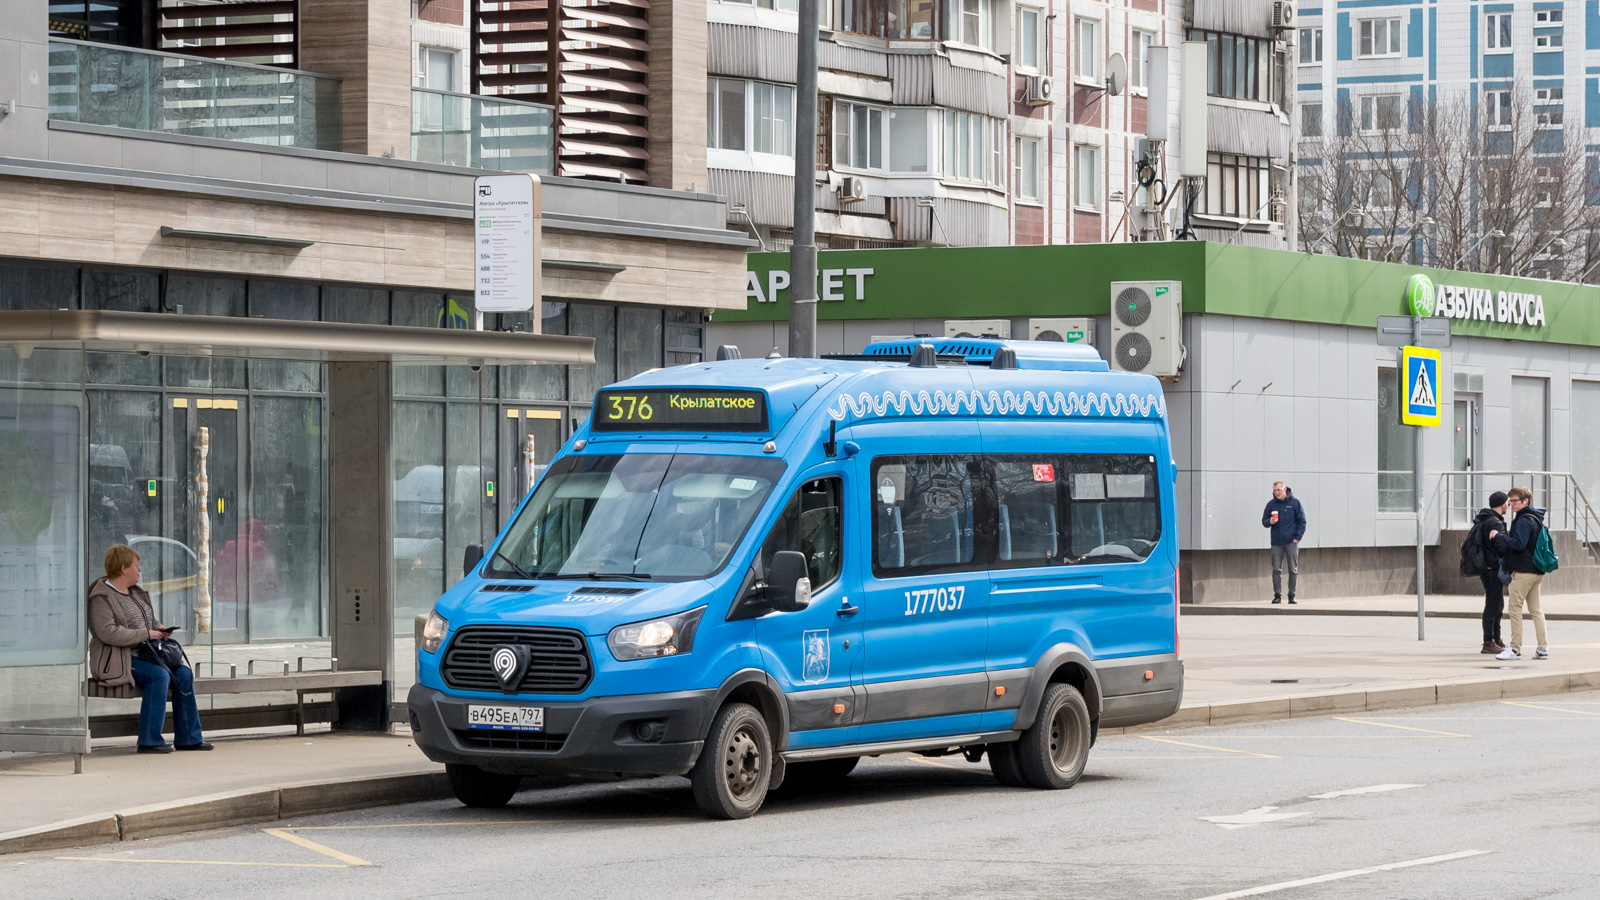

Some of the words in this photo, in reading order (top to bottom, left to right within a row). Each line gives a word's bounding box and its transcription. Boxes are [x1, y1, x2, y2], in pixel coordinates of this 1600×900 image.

[1434, 284, 1495, 321] АЗБУКА
[1496, 290, 1546, 327] ВКУСА
[608, 395, 653, 420] 376
[669, 394, 756, 410] Крылатское
[904, 585, 965, 616] 1777037
[521, 708, 540, 720] 797
